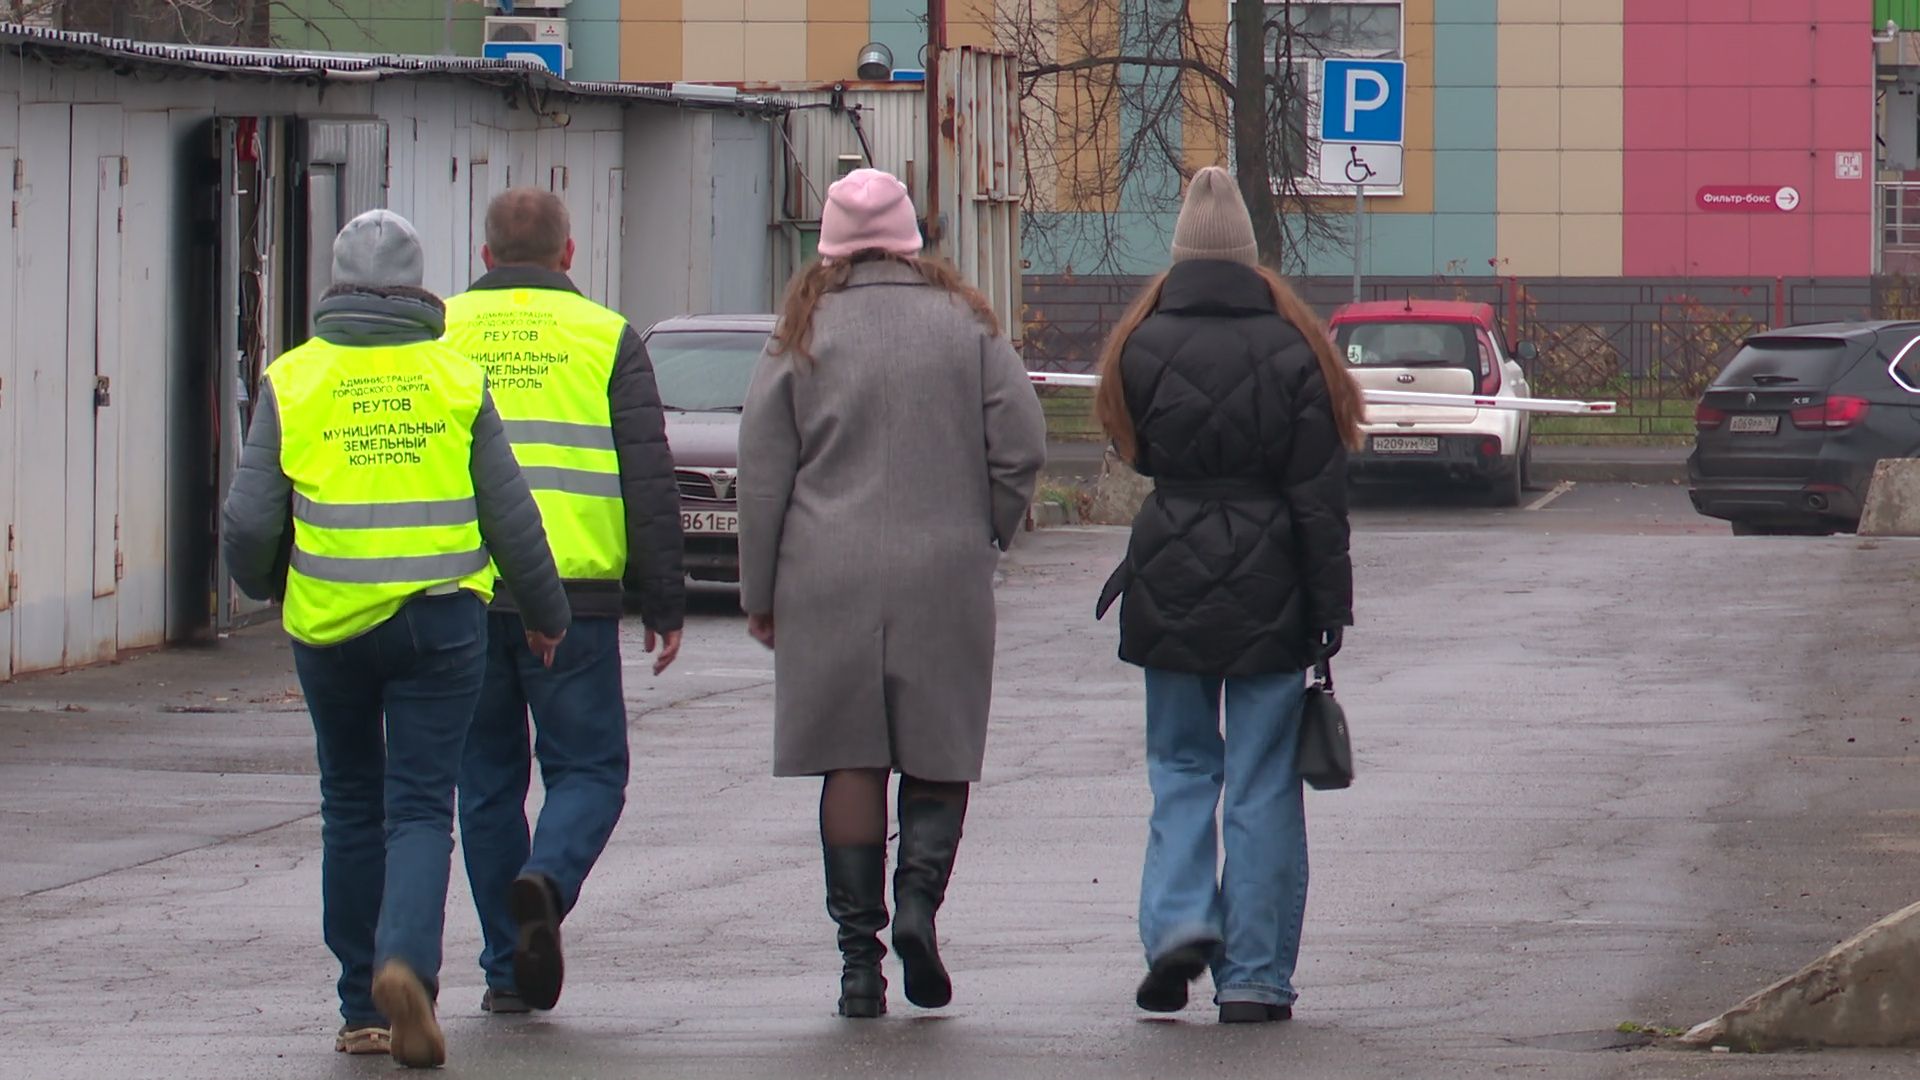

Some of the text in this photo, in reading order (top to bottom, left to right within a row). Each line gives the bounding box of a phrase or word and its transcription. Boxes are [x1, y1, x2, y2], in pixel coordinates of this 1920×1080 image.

[1344, 69, 1390, 133] P
[1703, 193, 1771, 204] Фильтр-бокс
[483, 330, 538, 342] РЕУТОВ
[464, 350, 569, 363] НИЦИПАЛЬНЫЙ
[480, 363, 549, 376] МЕЛЬНЫЙ
[340, 374, 423, 388] АДМИНИСТРАЦИЯ
[486, 377, 543, 389] ОНТРОЛЬ
[332, 383, 430, 399] ГОРОДСКОГО ОКРУГА
[353, 398, 412, 414] РЕУТОВ
[323, 419, 446, 441] МУНИЦИПАЛЬНЫЙ
[344, 434, 427, 452] ЗЕМЕЛЬНЫЙ
[349, 452, 421, 466] КОНТРОЛЬ
[681, 512, 737, 531] 861ЕР
